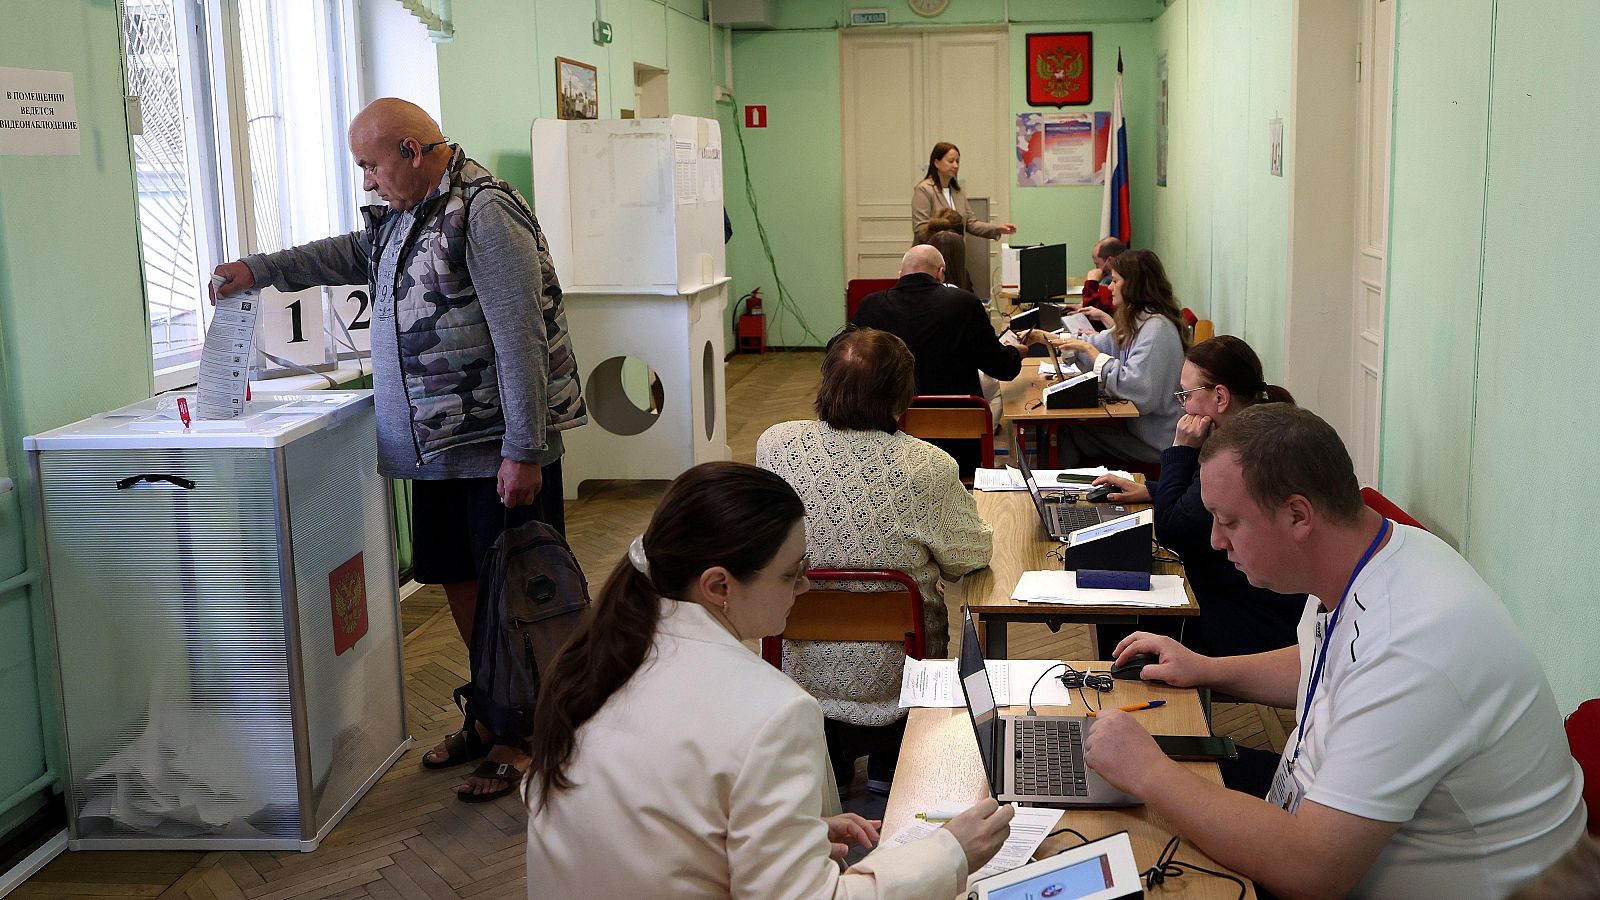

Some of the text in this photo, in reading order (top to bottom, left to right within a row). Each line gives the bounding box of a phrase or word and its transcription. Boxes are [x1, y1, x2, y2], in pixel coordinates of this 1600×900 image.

[7, 91, 65, 102] В ПОМЕЩЕНИИ
[20, 107, 54, 115] ВЕДЕТСЯ
[0, 120, 78, 130] ВИДЕОНАБЛЮДЕНИЕ
[346, 289, 371, 331] 2
[285, 299, 308, 343] 1
